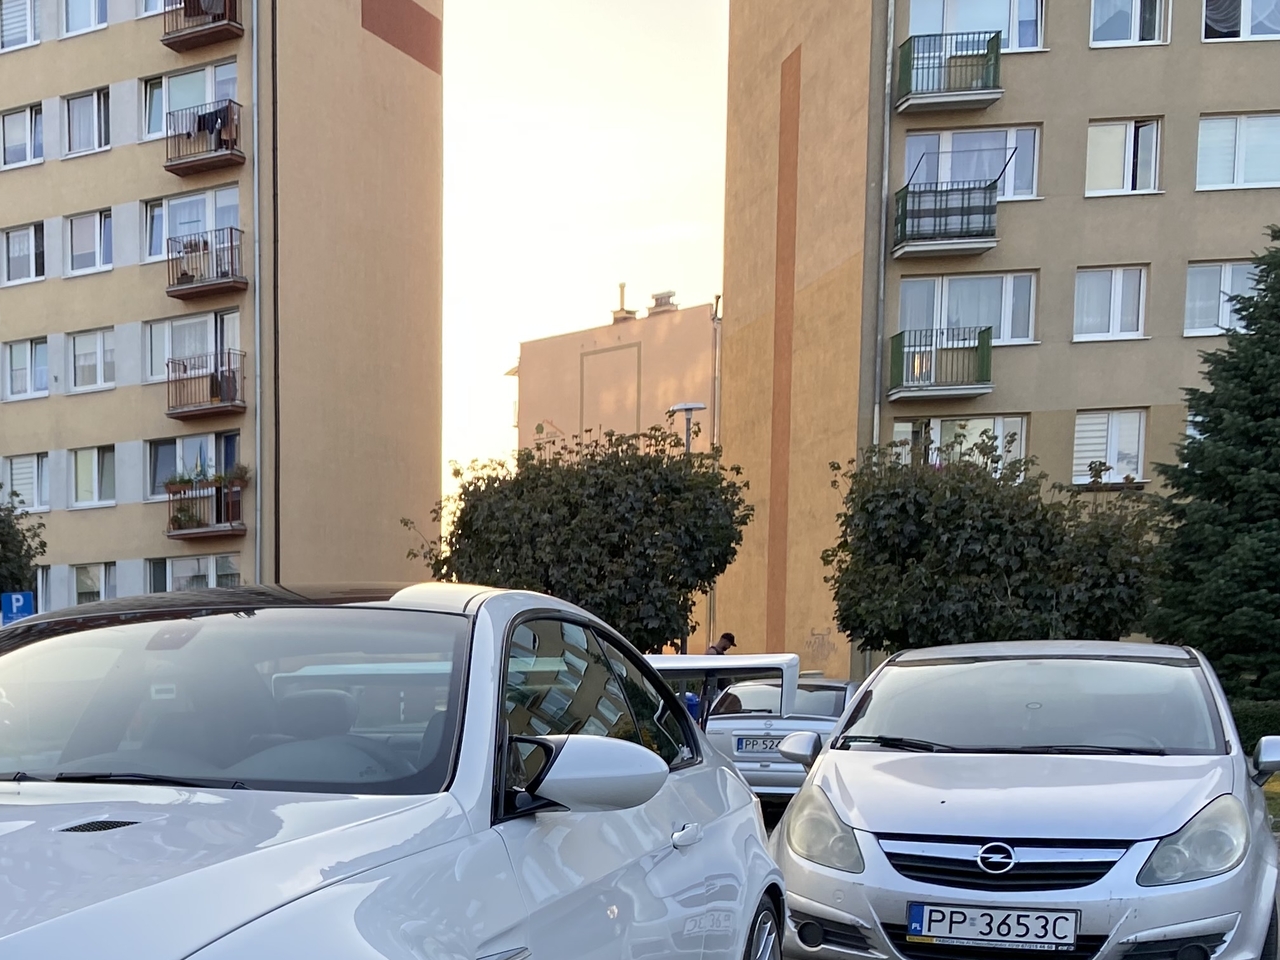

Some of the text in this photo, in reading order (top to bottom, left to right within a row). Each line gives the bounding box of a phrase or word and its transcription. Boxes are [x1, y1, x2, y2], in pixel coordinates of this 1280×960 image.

[11, 594, 24, 613] P
[744, 739, 758, 750] PP
[927, 909, 967, 934] PP
[978, 912, 1070, 940] 3653C
